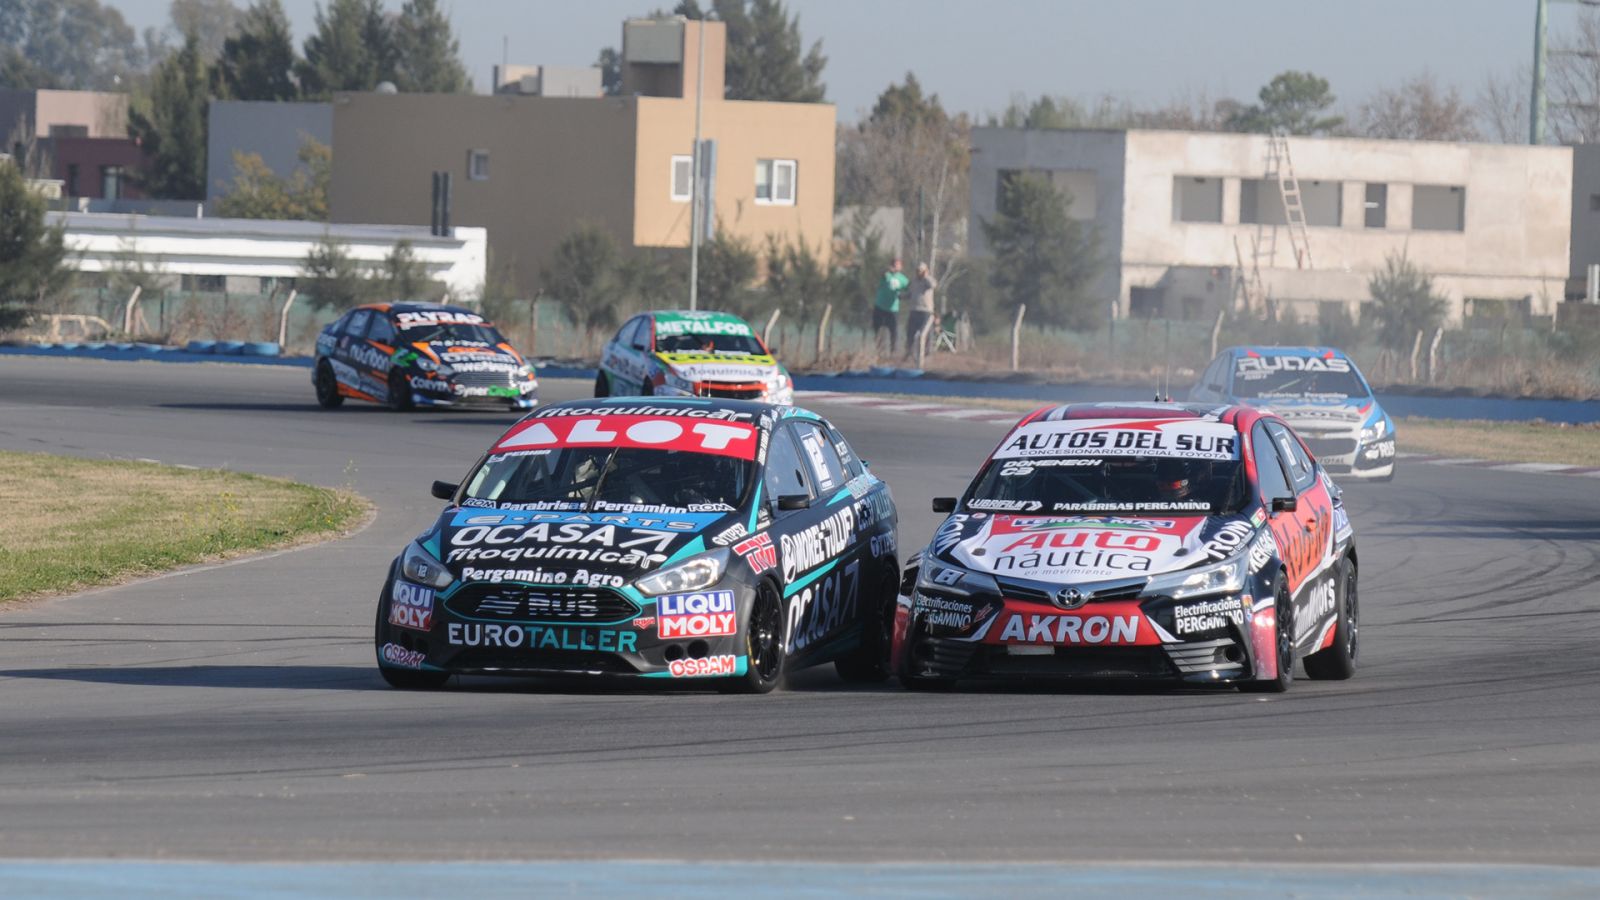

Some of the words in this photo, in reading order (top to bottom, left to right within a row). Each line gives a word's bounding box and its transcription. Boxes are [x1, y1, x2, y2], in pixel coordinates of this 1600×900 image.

[657, 320, 750, 335] METALFOR
[1238, 356, 1351, 373] RUDAS
[499, 419, 752, 449] ALOT
[1006, 432, 1103, 450] AUTOS
[1114, 431, 1167, 450] DEL
[1175, 434, 1235, 454] SUR
[1003, 459, 1103, 468] DOMENECH
[1179, 451, 1228, 459] TOYOTA
[1053, 501, 1134, 511] PARABRISAS
[1135, 500, 1211, 510] PERGAMINO
[450, 522, 616, 547] OCASA
[1002, 531, 1162, 552] Auto
[993, 550, 1151, 571] náutica
[461, 567, 567, 585] Pergamino
[572, 569, 625, 588] Agro
[662, 592, 731, 614] LIQUI
[1174, 598, 1242, 619] Electrificaciones
[663, 613, 733, 637] MOLY
[1000, 614, 1139, 643] AKRON
[448, 622, 637, 653] EUROTALLER
